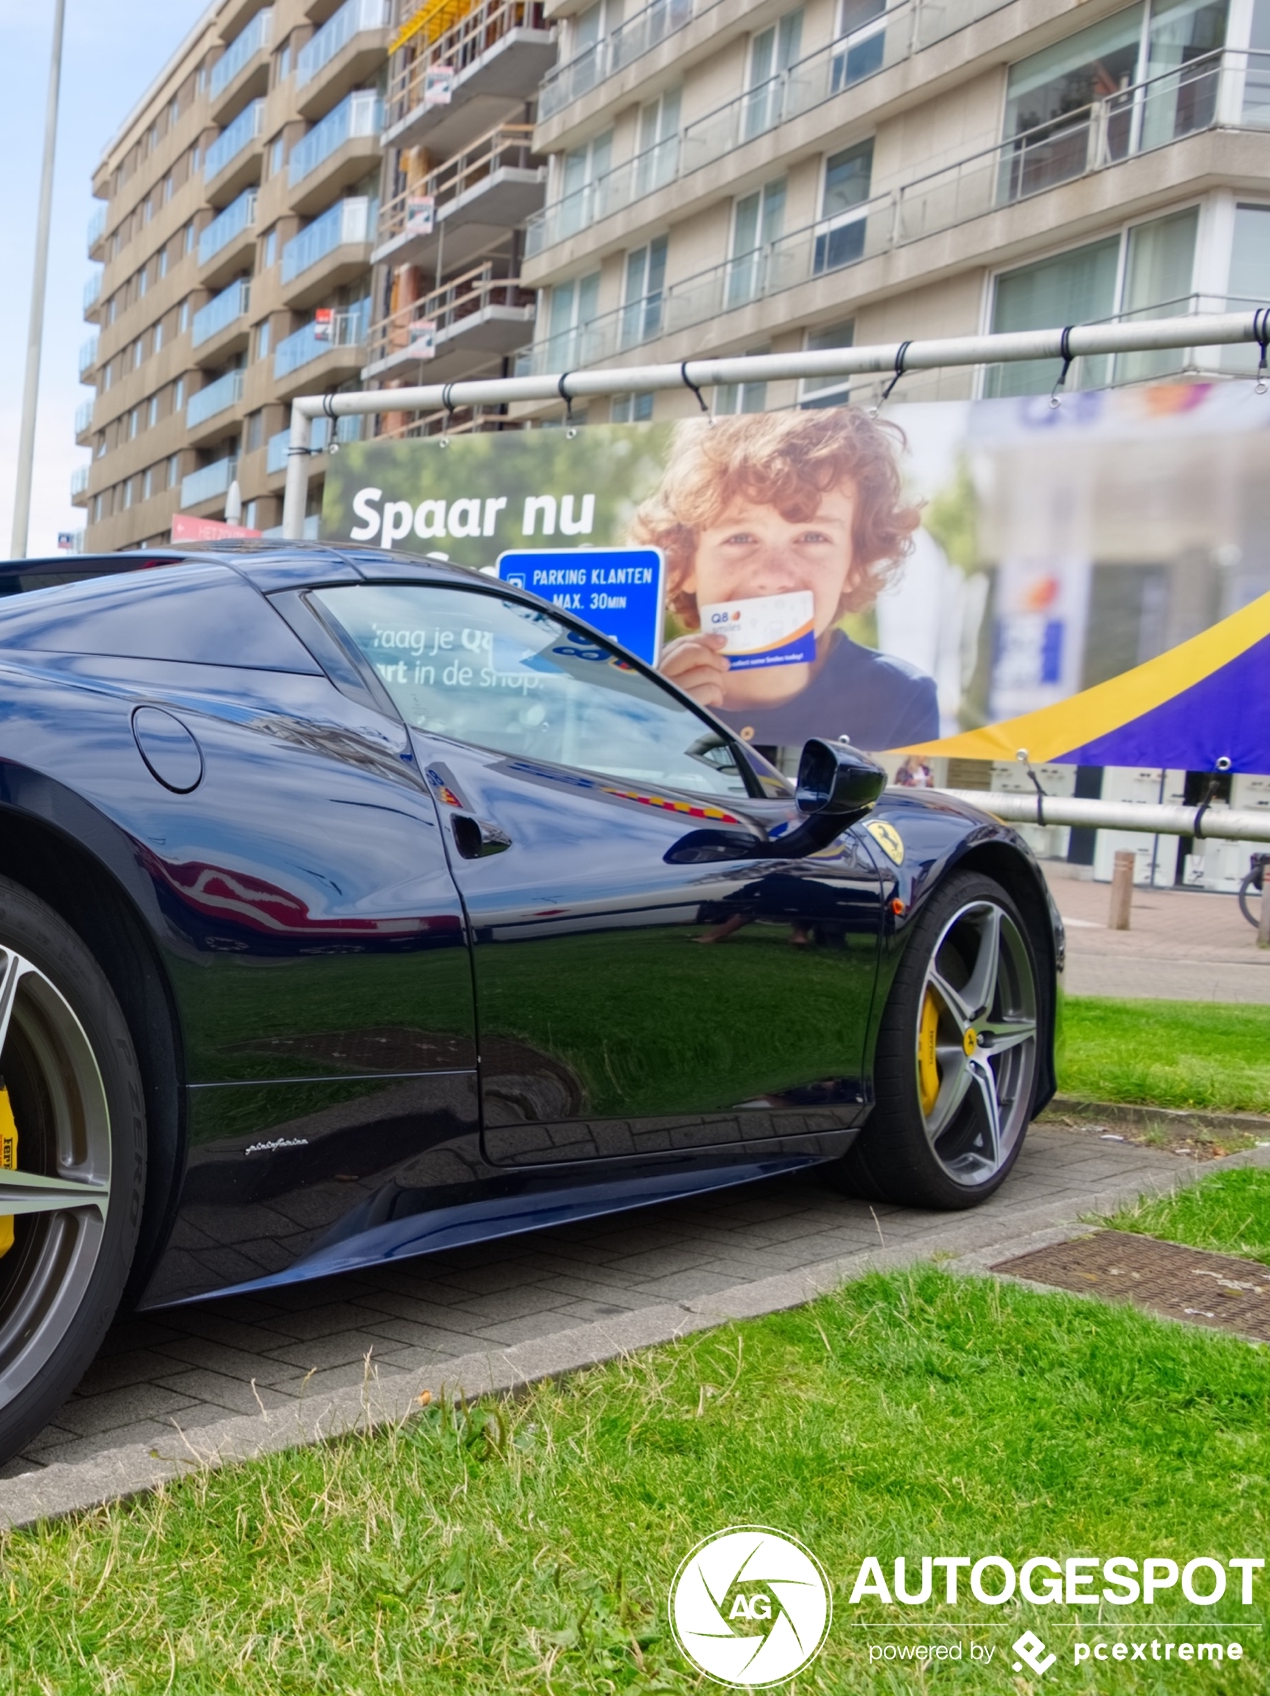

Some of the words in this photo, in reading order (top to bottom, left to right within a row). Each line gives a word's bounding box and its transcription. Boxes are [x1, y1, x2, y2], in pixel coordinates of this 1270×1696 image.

[349, 487, 507, 549] Spaar
[522, 493, 596, 536] nu
[533, 569, 587, 586] PARKING
[591, 567, 653, 585] KLANTEN
[552, 593, 585, 610] MAX.
[589, 593, 627, 610] 30MIN
[711, 611, 729, 624] Q8
[372, 623, 426, 657] raag
[429, 626, 455, 657] je
[414, 660, 435, 686] in
[442, 658, 474, 687] de
